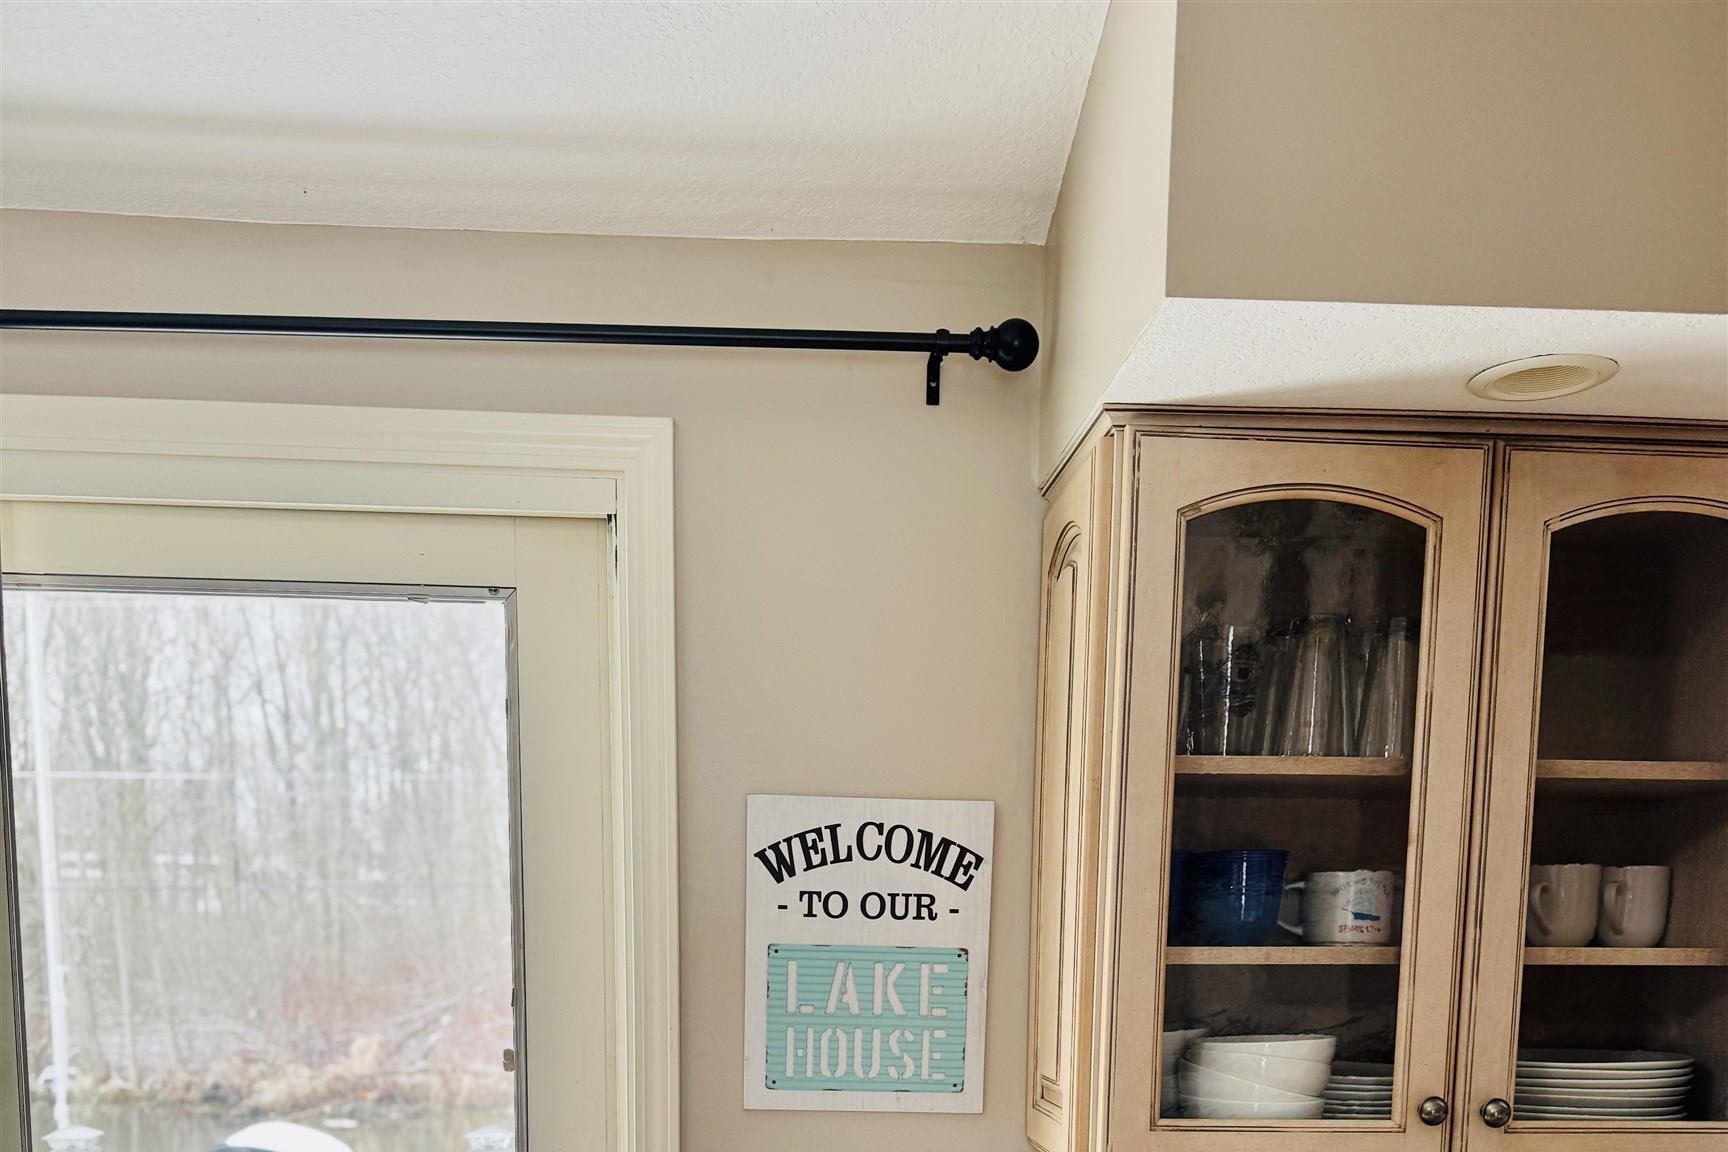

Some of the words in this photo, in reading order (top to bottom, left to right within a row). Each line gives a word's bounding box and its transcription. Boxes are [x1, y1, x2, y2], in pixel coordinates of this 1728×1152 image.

[754, 821, 985, 892] WELCOME
[799, 890, 849, 920] TO
[859, 892, 938, 922] OUR
[785, 960, 949, 1017] LAKE
[785, 1027, 947, 1081] HOUSE
